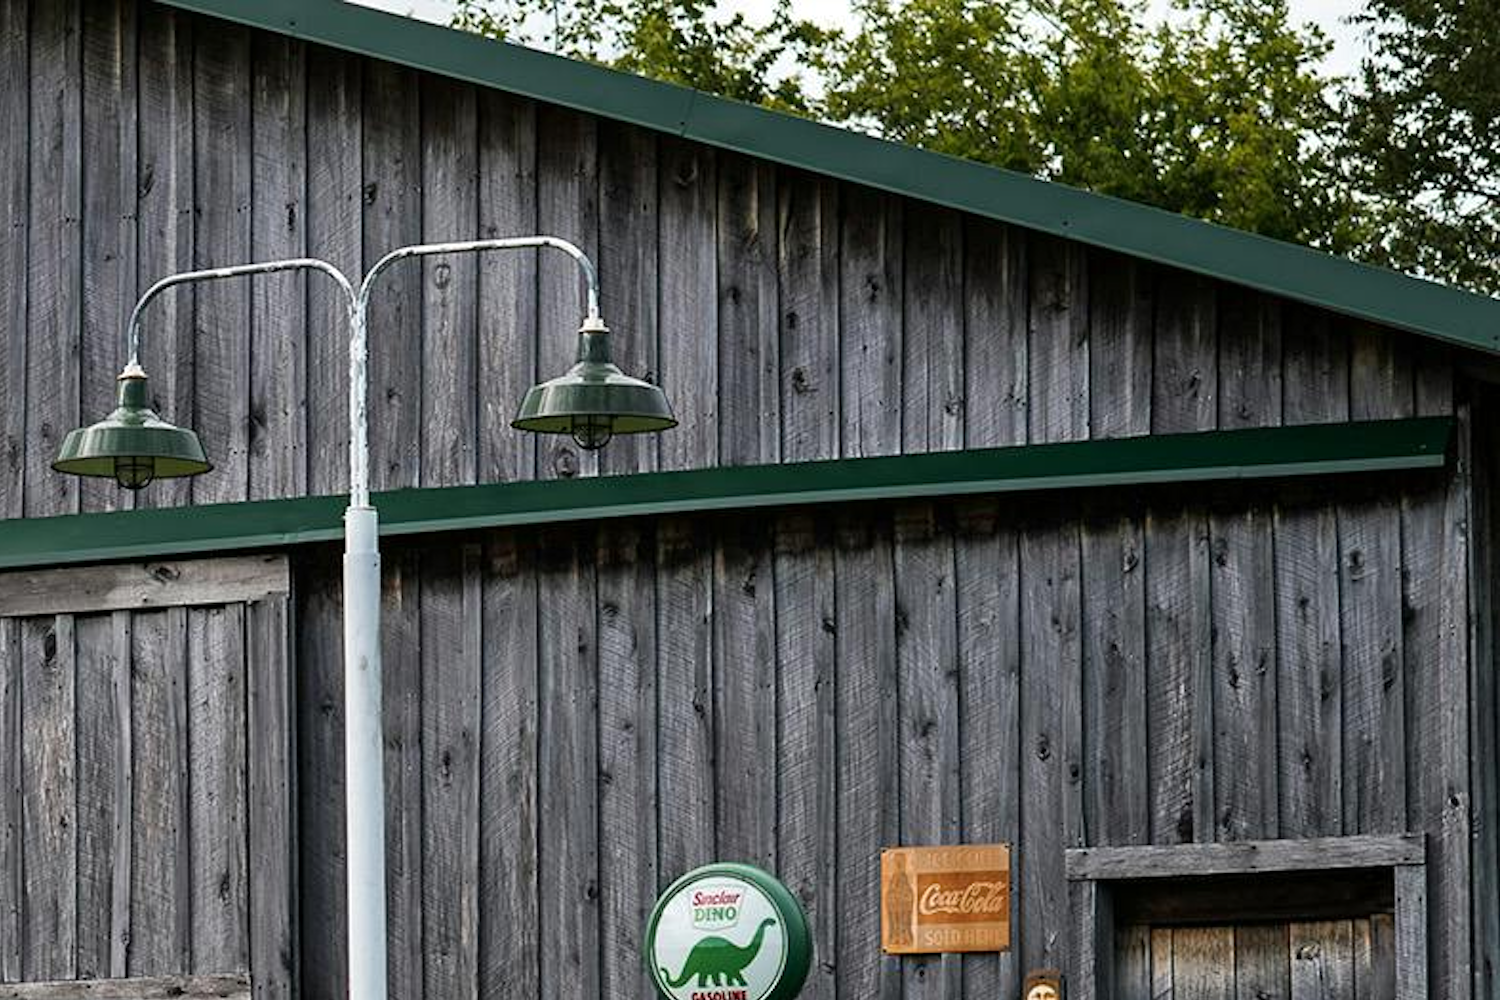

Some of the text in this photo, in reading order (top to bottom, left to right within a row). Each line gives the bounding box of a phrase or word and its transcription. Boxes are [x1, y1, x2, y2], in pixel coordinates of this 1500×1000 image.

[692, 889, 740, 906] Sinclair
[920, 881, 1006, 915] Coca-Cola
[694, 906, 737, 923] DINO
